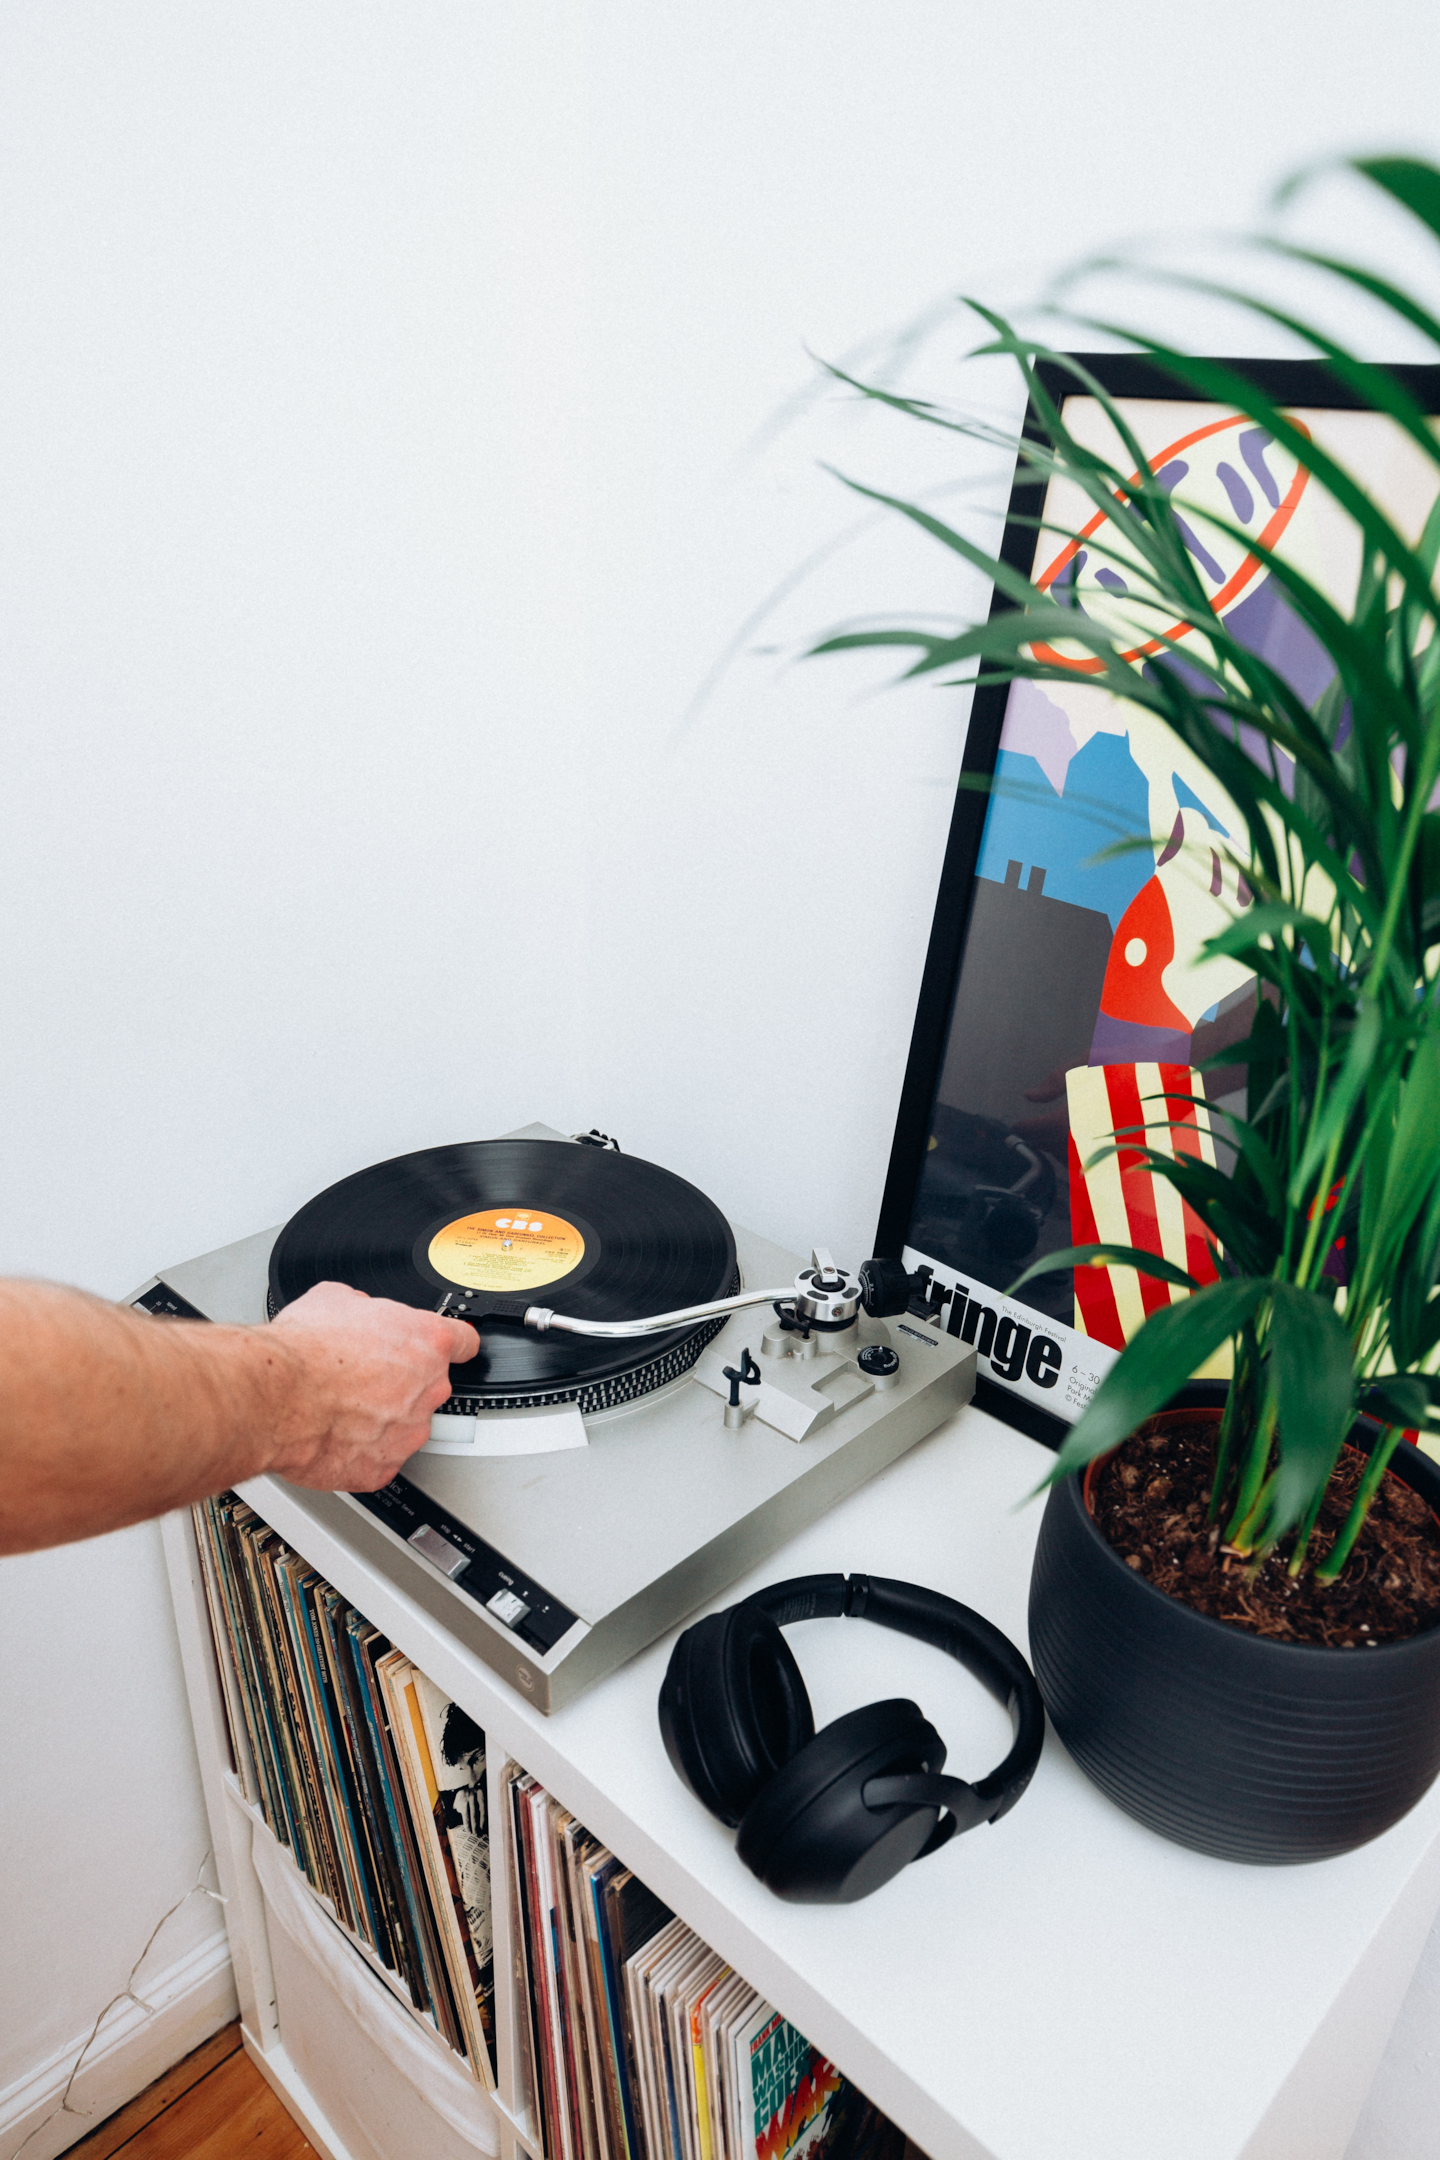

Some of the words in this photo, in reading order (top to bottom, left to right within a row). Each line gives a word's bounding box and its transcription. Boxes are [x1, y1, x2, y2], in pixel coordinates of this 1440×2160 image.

[495, 1218, 543, 1232] CBS
[167, 1302, 178, 1311] speed
[1002, 1305, 1013, 1316] The
[1013, 1311, 1043, 1331] Edinburgh
[1044, 1327, 1066, 1343] Festival
[1072, 1365, 1078, 1374] 6
[1088, 1373, 1100, 1385] 30
[1067, 1385, 1082, 1398] Park
[401, 1502, 415, 1517] Servo
[440, 1523, 451, 1534] stop
[463, 1542, 476, 1554] start
[498, 1571, 514, 1586] cueing
[308, 1608, 316, 1621] TOM
[311, 1620, 319, 1637] JONES
[315, 1643, 325, 1670] GREATEST
[320, 1670, 328, 1683] HITS
[750, 2024, 771, 2055] FRANK
